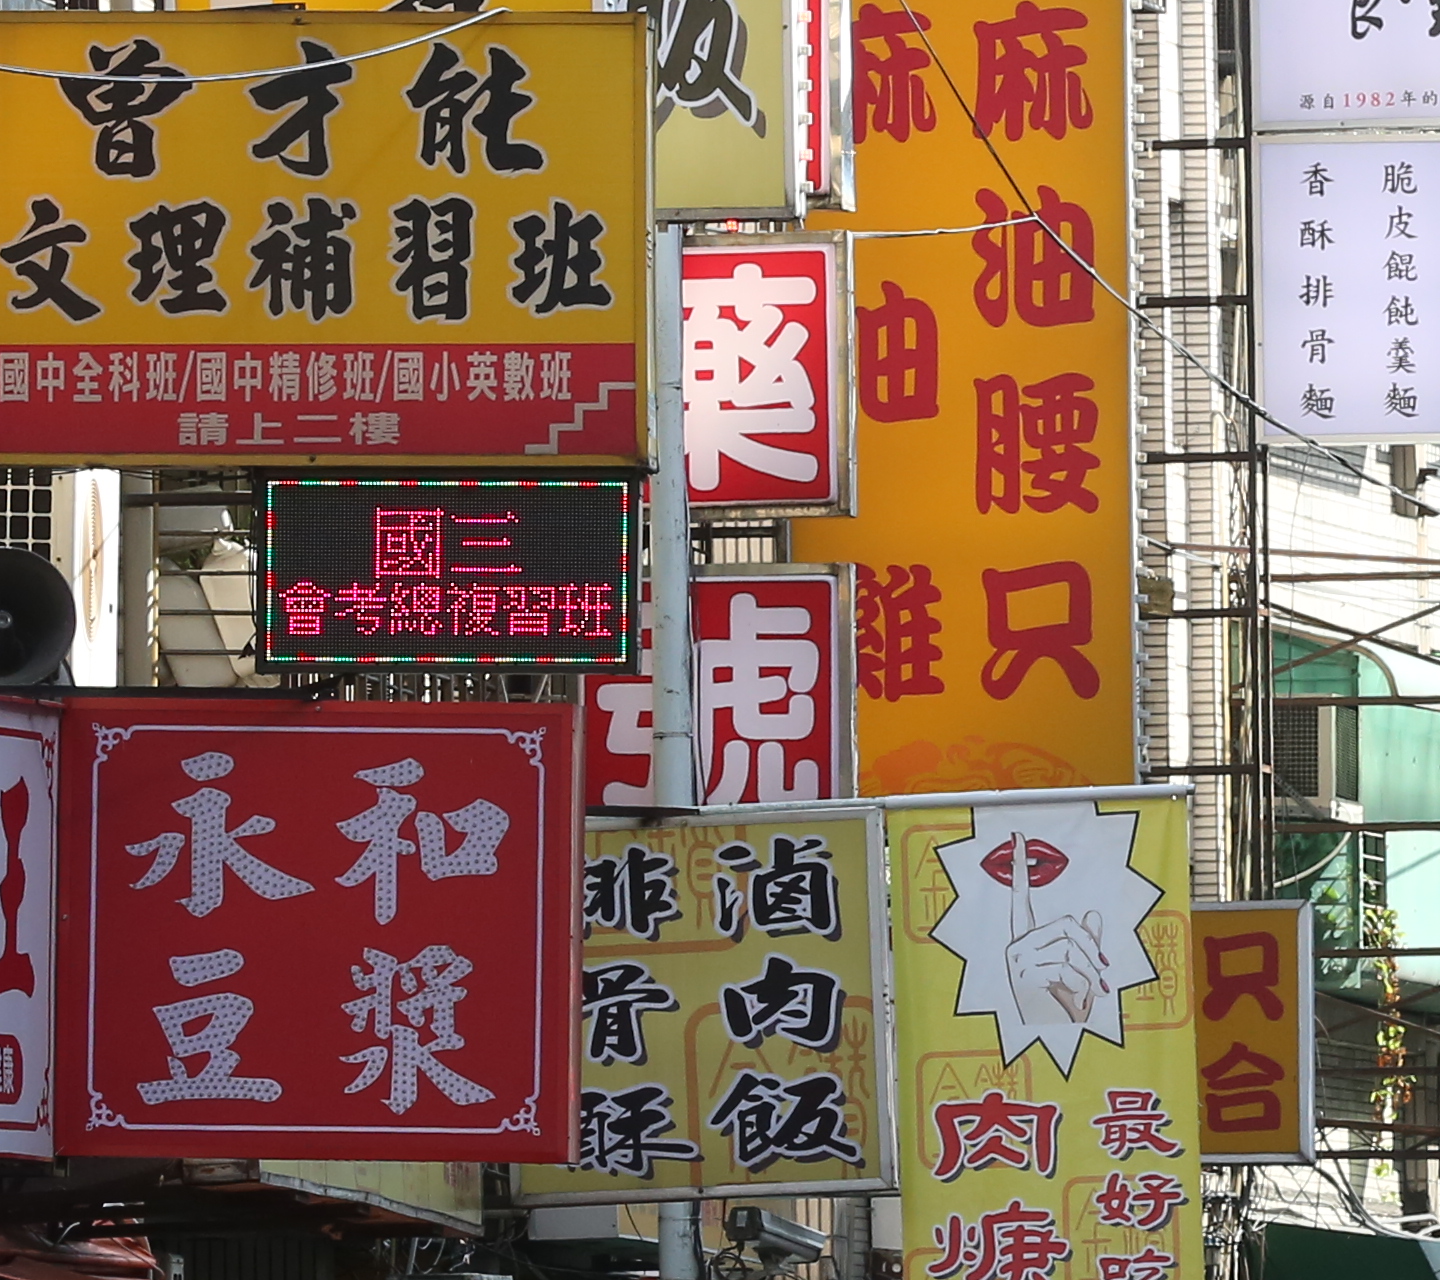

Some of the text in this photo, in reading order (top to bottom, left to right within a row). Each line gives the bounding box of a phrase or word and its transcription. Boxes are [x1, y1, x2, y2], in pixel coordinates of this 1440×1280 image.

[58, 36, 550, 180] 曾才能
[972, 1, 1100, 700] 麻油腰只
[1299, 161, 1337, 420] 香酥排骨麵
[177, 411, 401, 448] 請上二樓
[279, 582, 613, 637] 會考總複習班
[374, 507, 522, 579] 國三
[125, 751, 510, 925] 永和
[136, 944, 496, 1114] 豆漿
[710, 835, 862, 1171] 滷肉飯
